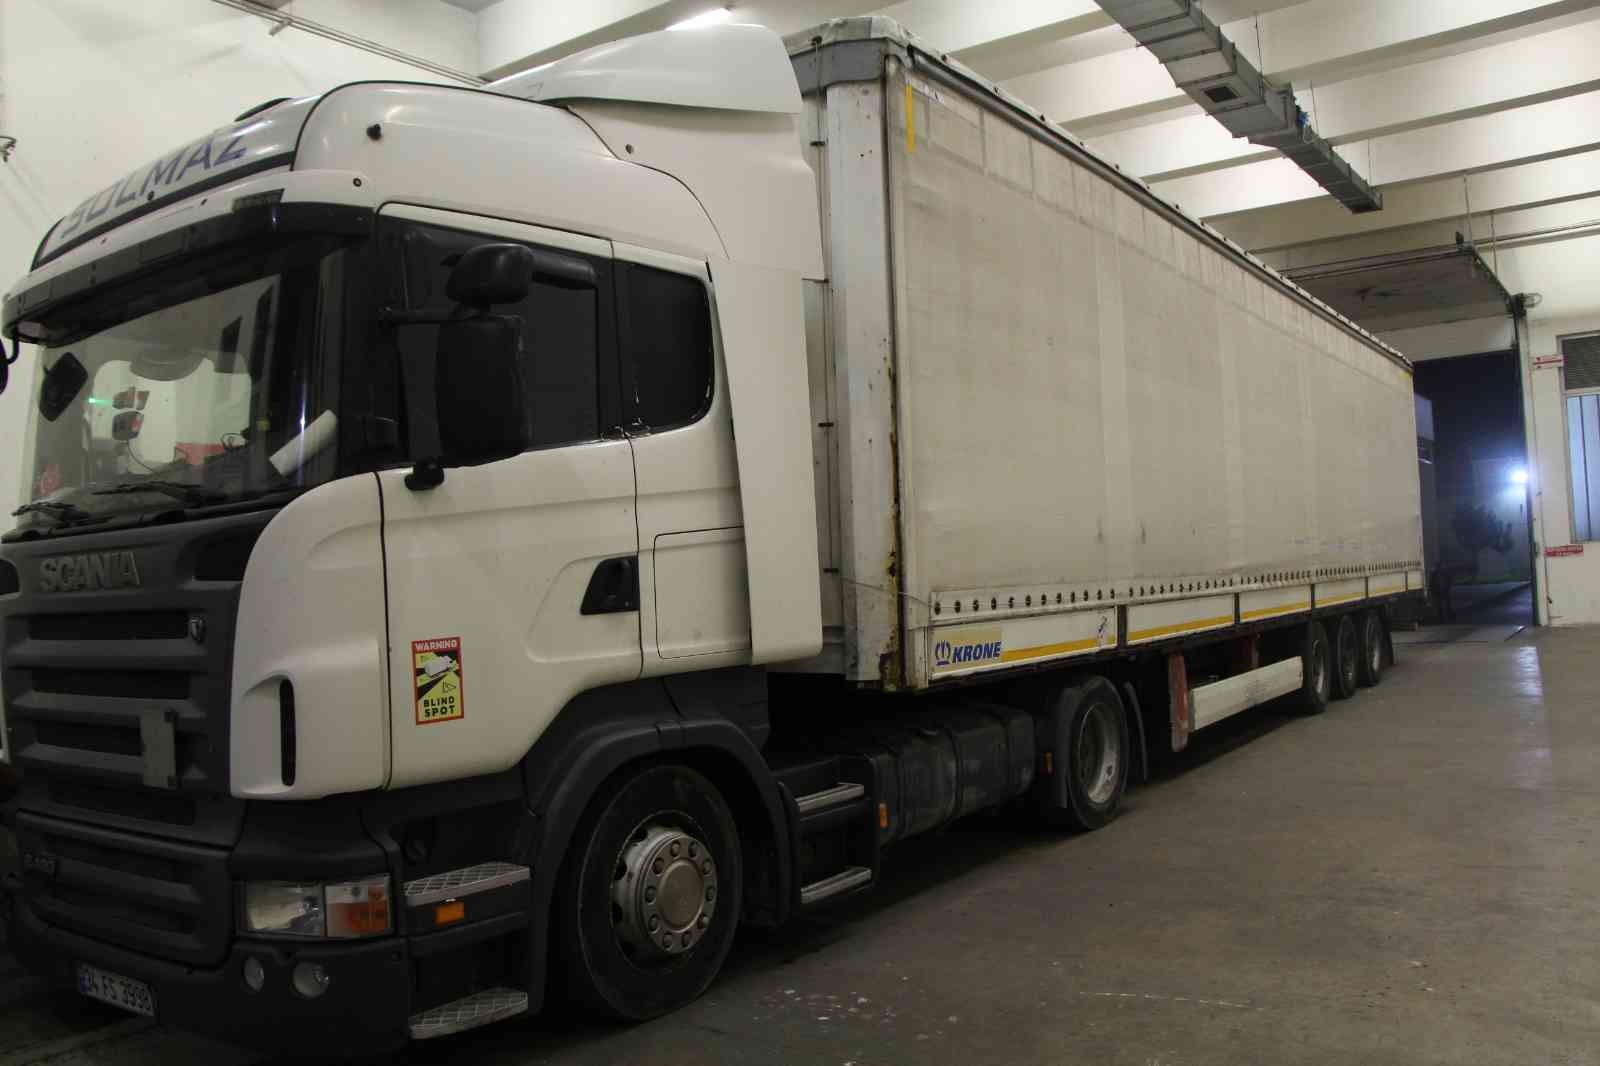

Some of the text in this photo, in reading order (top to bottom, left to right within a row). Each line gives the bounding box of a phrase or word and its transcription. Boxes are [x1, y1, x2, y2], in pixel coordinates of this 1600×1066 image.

[60, 119, 261, 239] SOLMAZ
[40, 552, 140, 592] SCANIA
[415, 640, 457, 651] WARNING
[952, 641, 1001, 663] KRONE
[423, 696, 455, 708] BLIND
[424, 705, 455, 718] SPOT
